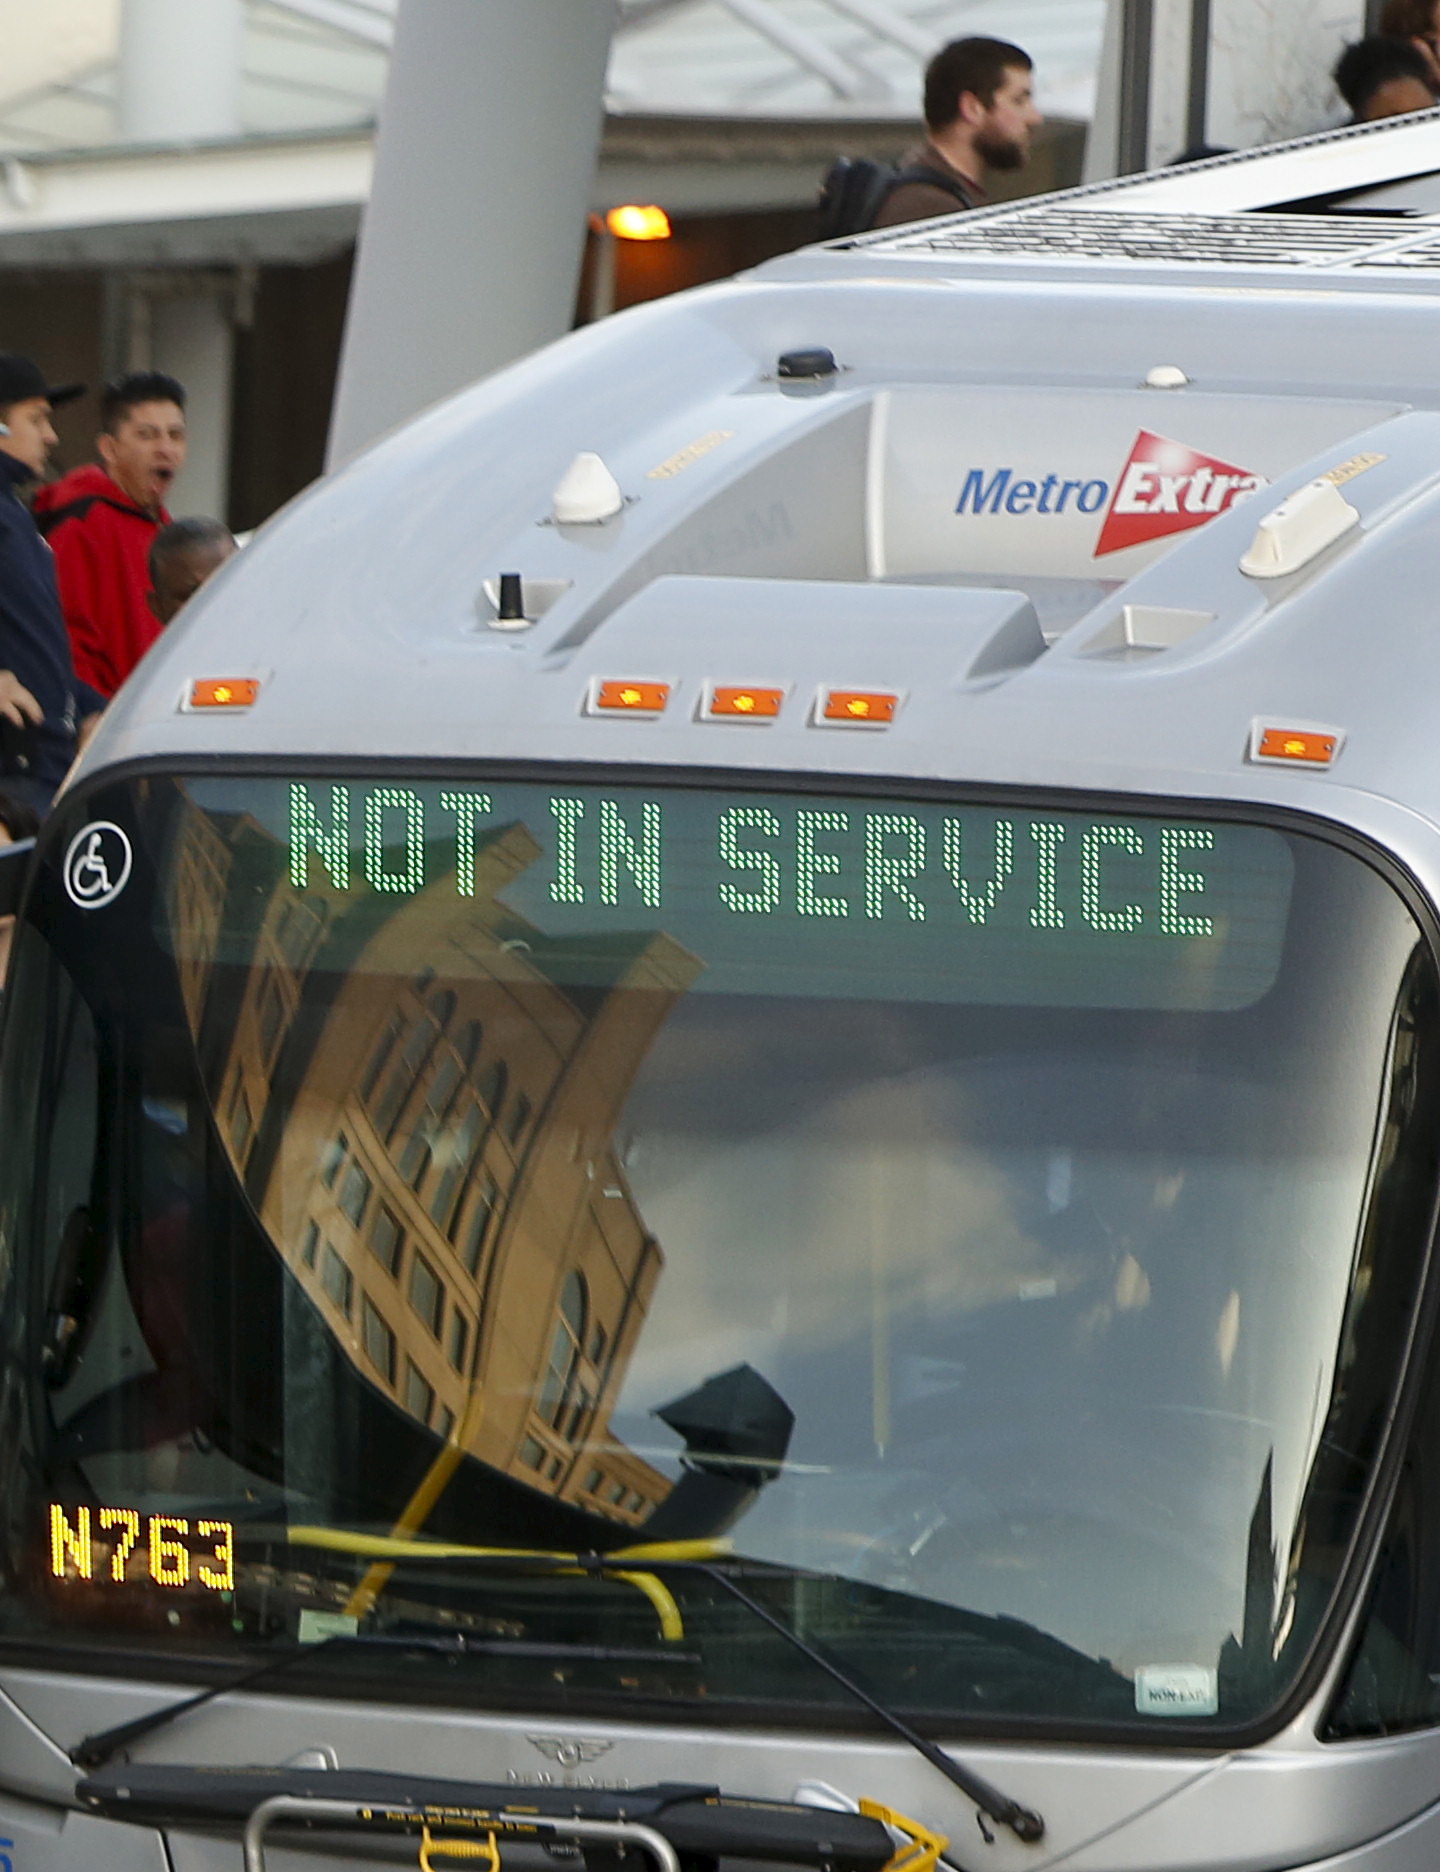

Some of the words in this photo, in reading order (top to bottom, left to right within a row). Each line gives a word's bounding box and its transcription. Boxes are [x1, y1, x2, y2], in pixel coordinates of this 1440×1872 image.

[288, 782, 492, 899] NOT
[548, 795, 662, 908] IN
[718, 806, 1215, 936] SERVICE
[50, 1503, 235, 1591] N763
